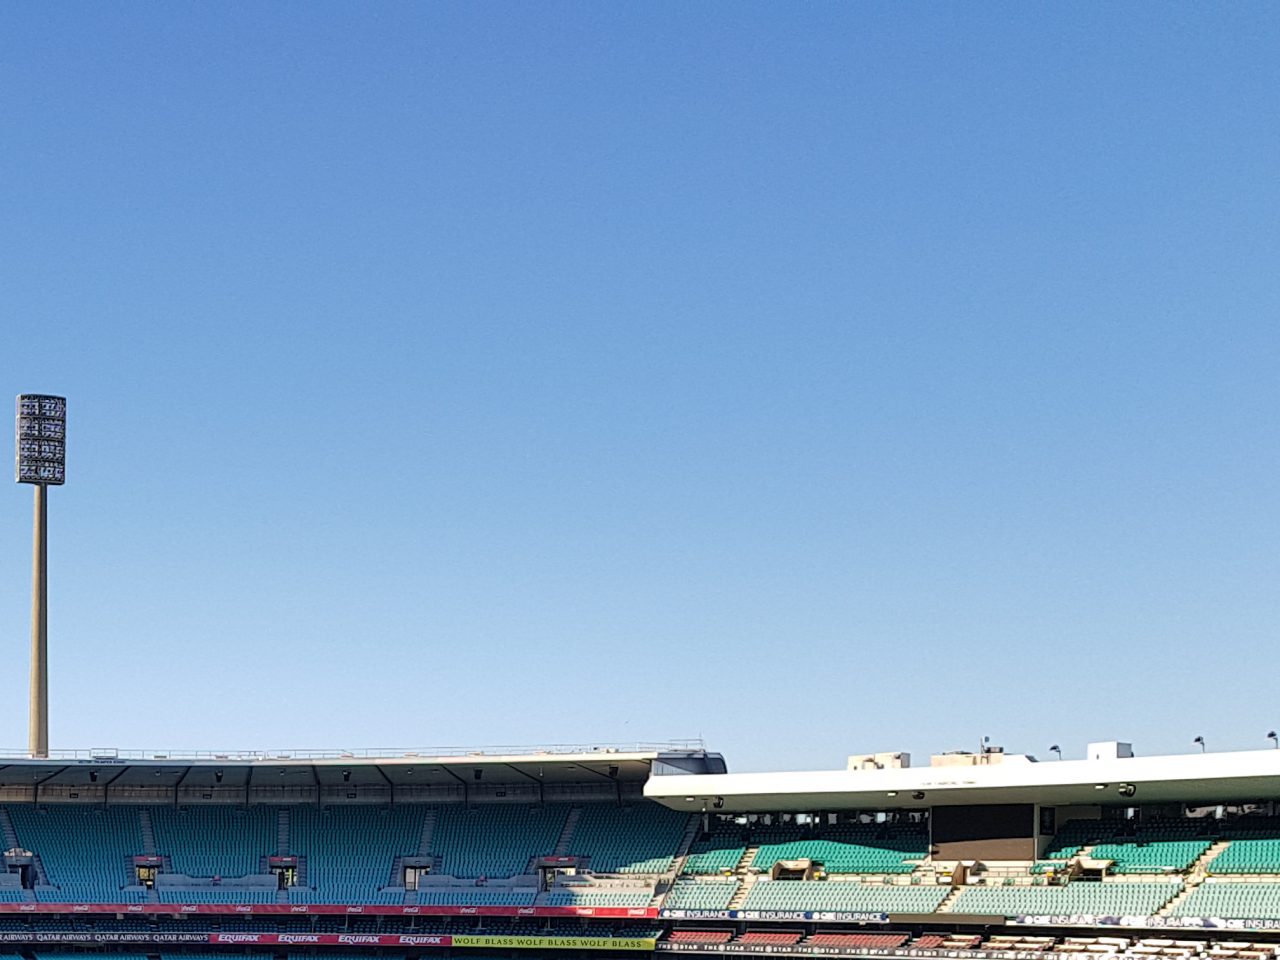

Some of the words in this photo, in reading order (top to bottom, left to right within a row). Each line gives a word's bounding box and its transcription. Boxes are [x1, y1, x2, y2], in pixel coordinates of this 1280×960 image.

[761, 911, 804, 919] INSURANCE
[837, 912, 881, 920] INSURANCE
[218, 935, 259, 943] EQUIFAX
[278, 935, 318, 943] EQUIFAX
[338, 935, 380, 944] EQUIFAX
[399, 935, 442, 944] EQUIFAX
